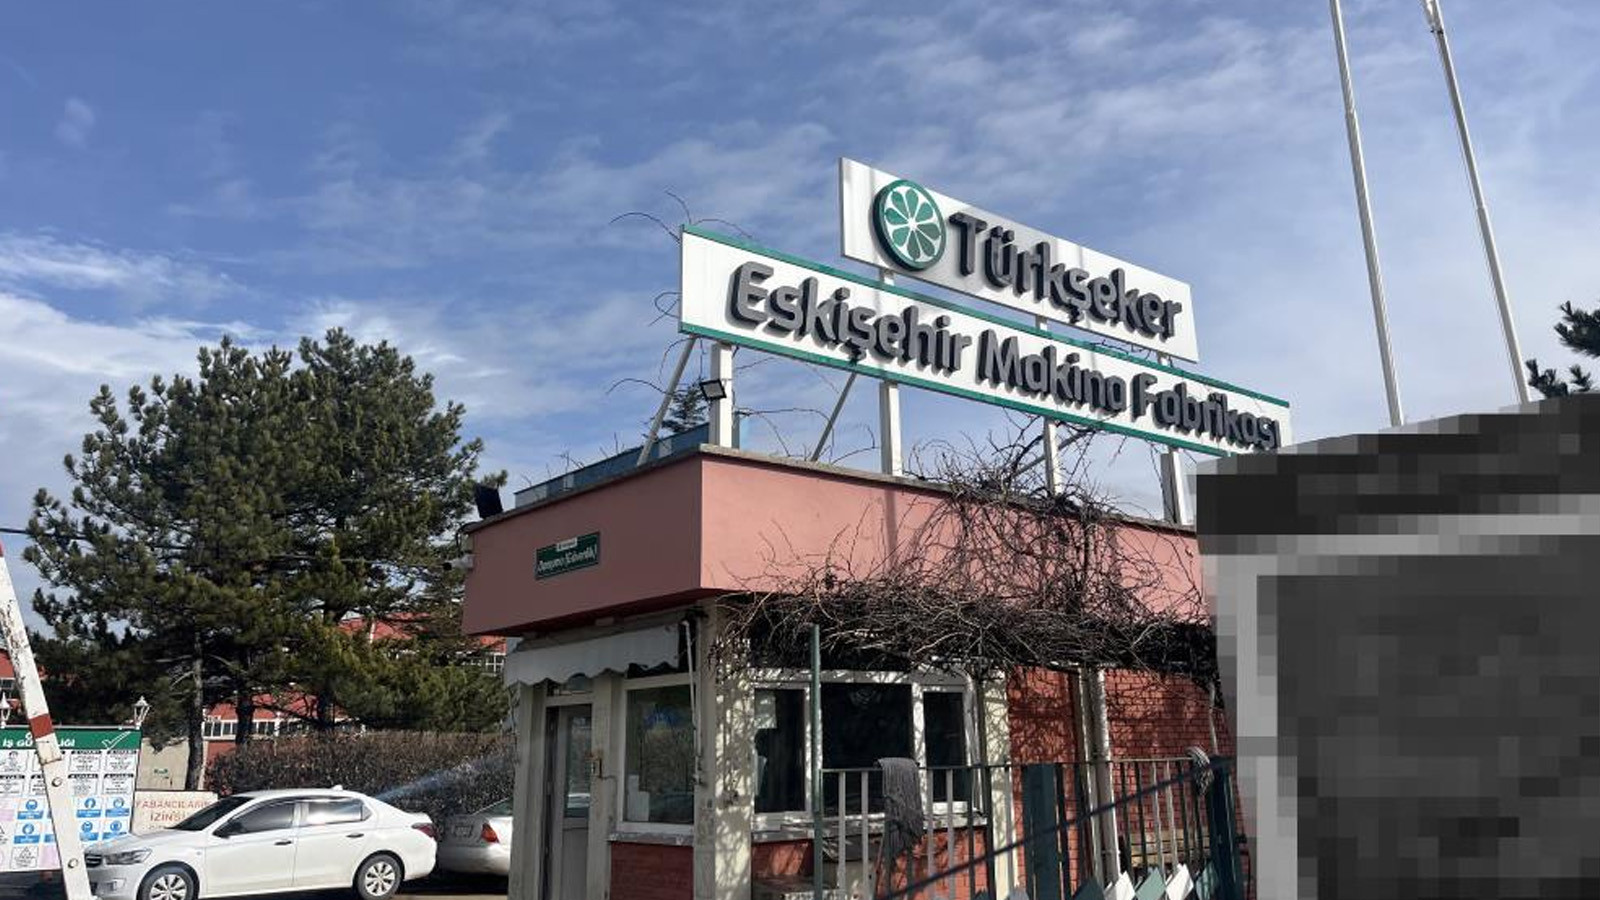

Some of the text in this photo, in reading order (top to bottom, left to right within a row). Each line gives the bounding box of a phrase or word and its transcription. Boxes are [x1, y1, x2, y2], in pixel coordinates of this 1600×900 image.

[727, 261, 1282, 450] Eskişehir Makina Fabrikası
[948, 211, 1182, 342] Türkşeker
